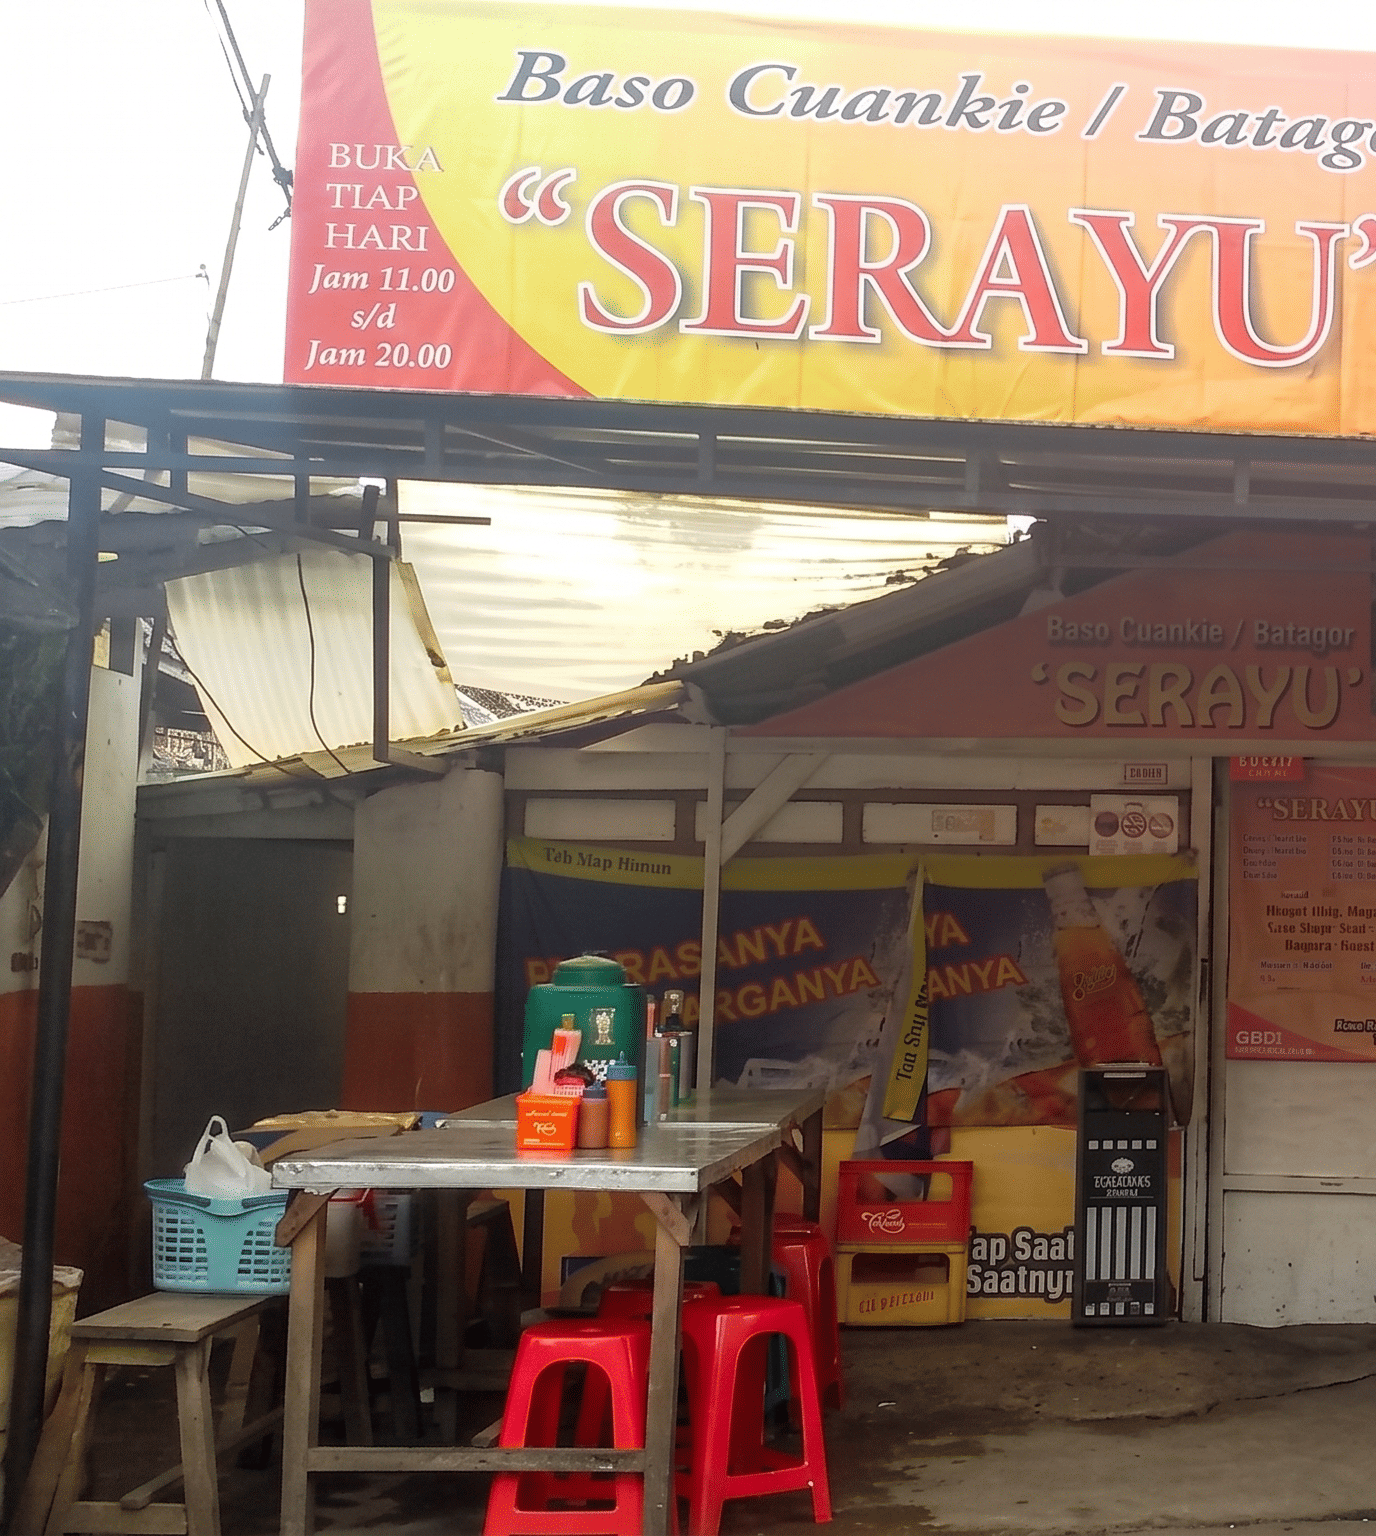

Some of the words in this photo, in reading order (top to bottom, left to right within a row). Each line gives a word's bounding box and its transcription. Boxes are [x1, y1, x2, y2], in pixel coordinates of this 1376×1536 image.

[497, 49, 697, 112] Baso
[728, 61, 1066, 137] Cuankie
[327, 143, 443, 174] BUKA
[326, 182, 418, 212] TIAP
[323, 222, 429, 253] HARI
[308, 262, 369, 295] Jam
[379, 266, 456, 294] 11.00
[351, 303, 396, 331] s/d
[305, 341, 367, 371] Jam
[373, 342, 453, 370] 20.00
[1046, 614, 1109, 642] Baso
[1118, 616, 1224, 644] Cuankie
[1254, 620, 1355, 653] Batagor
